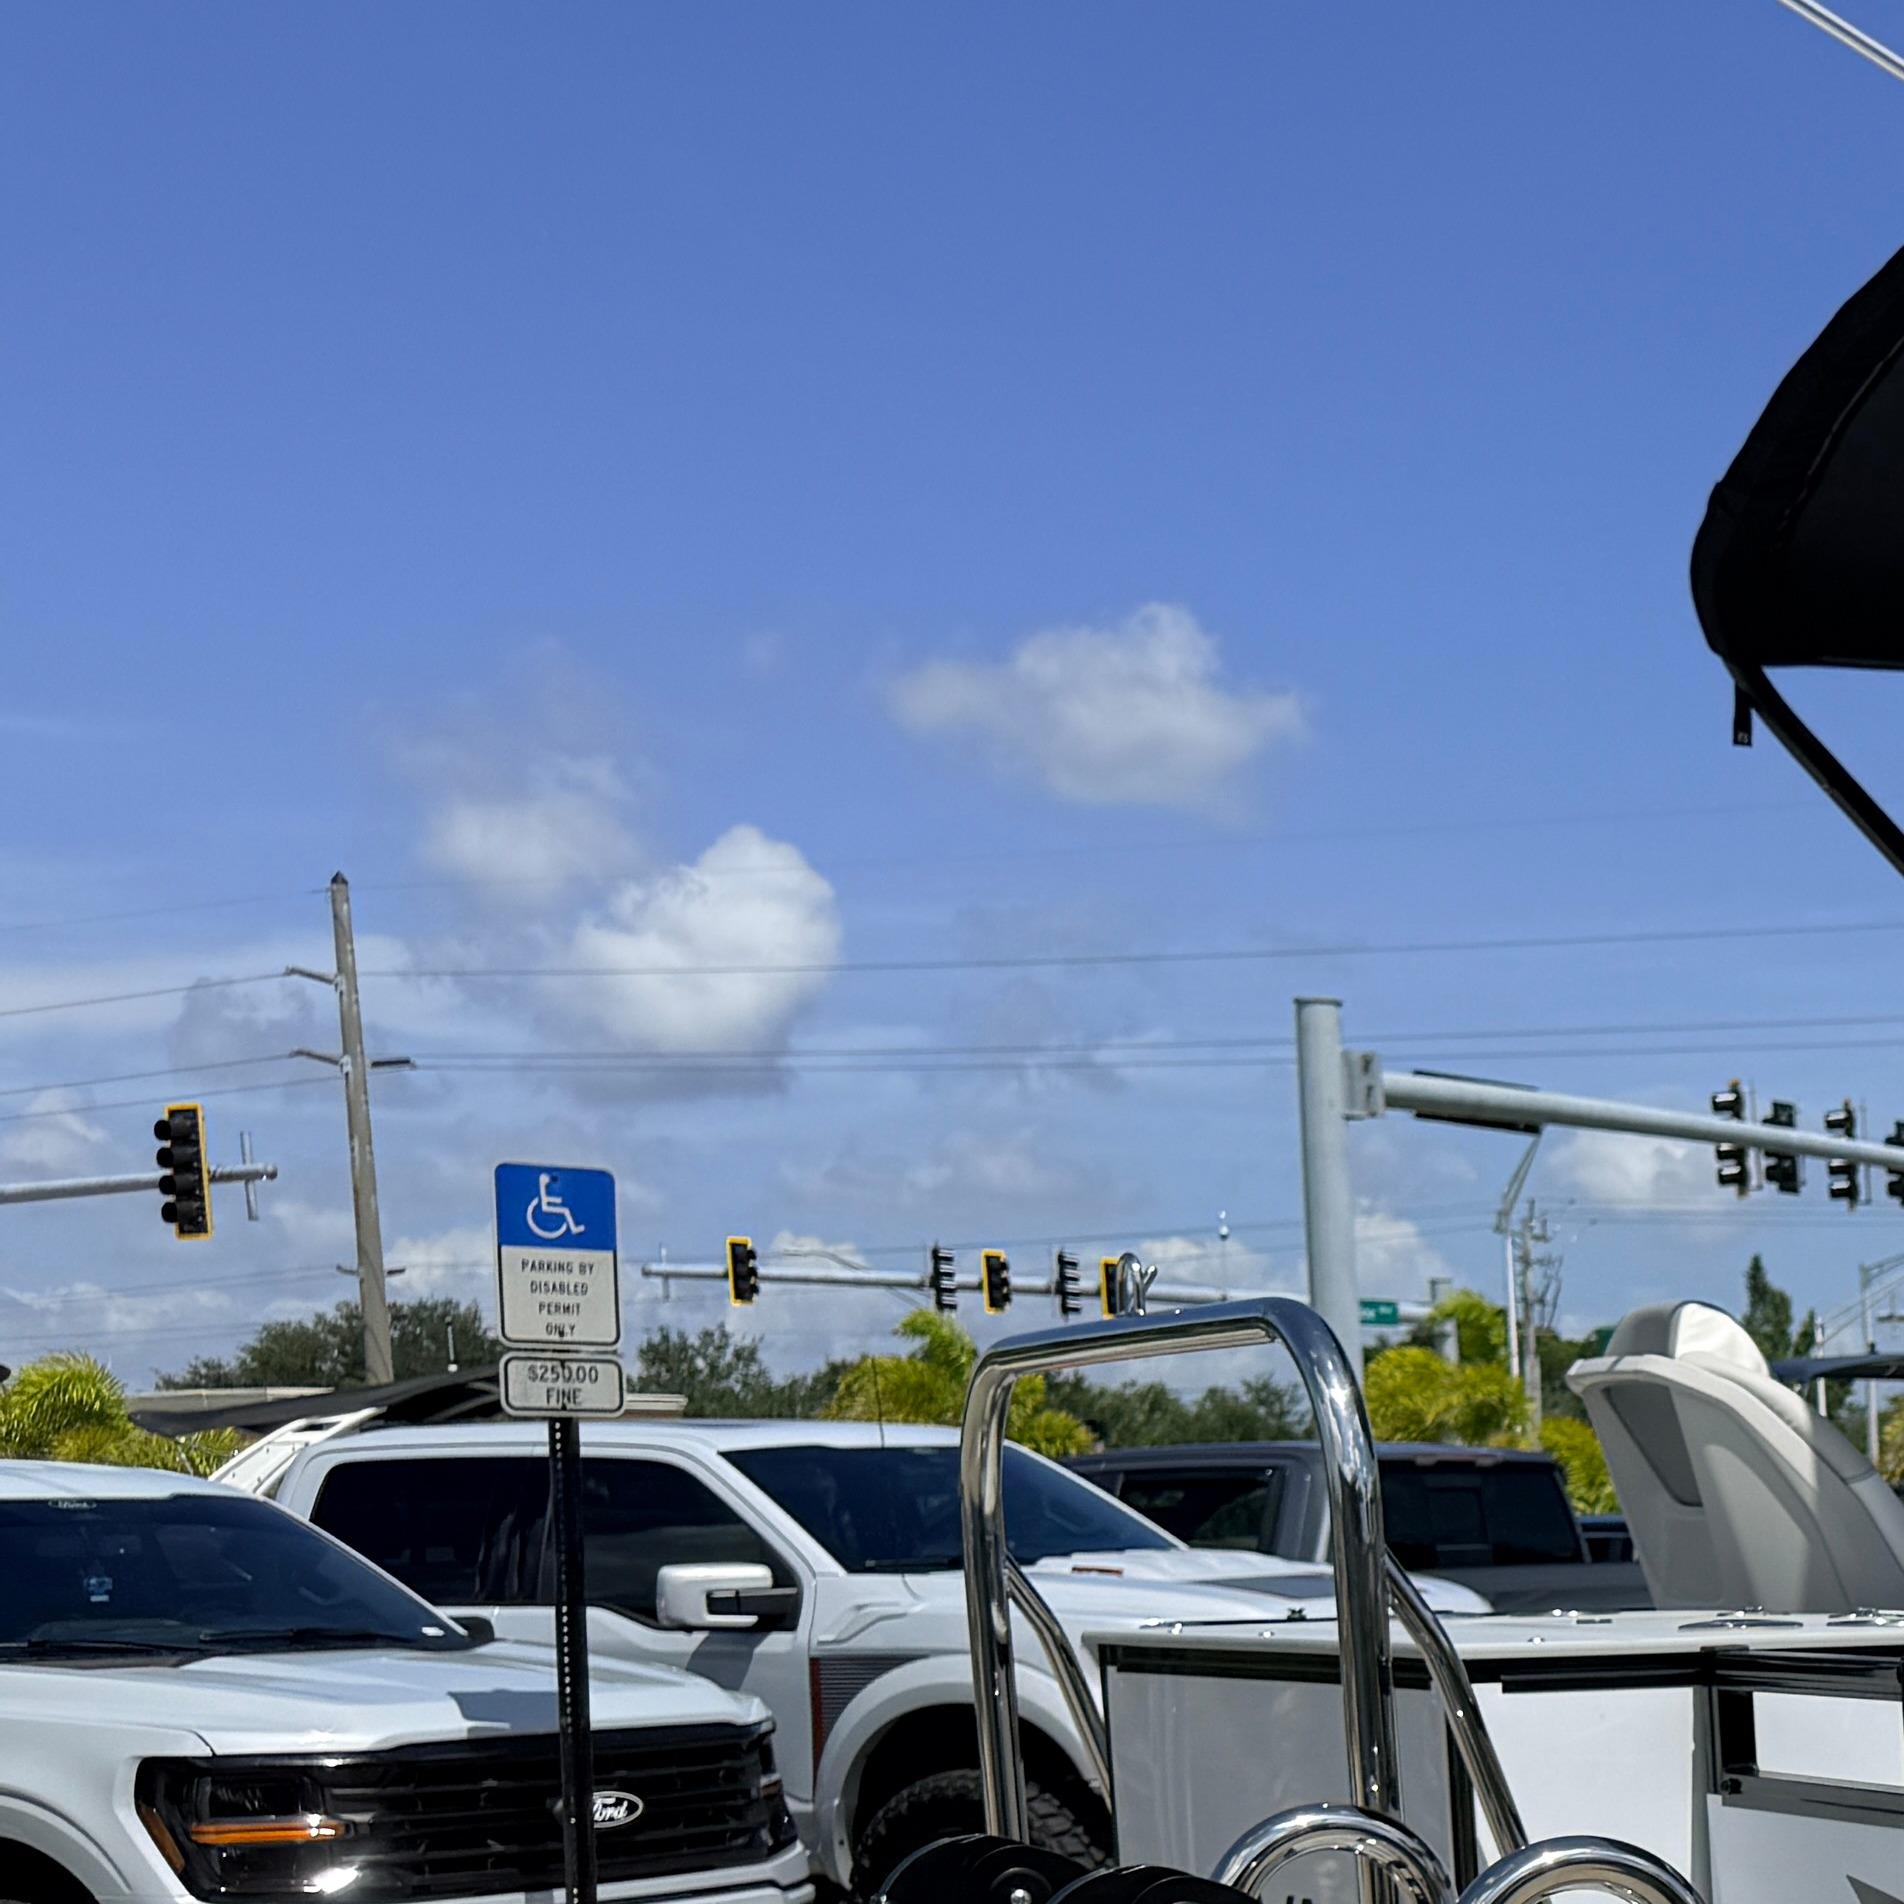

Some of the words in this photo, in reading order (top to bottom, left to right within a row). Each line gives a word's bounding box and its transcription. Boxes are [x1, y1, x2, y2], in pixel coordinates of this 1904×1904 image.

[521, 1258, 574, 1275] PARKING
[578, 1261, 595, 1276] BY
[530, 1281, 589, 1296] DISABLED
[538, 1303, 581, 1317] PERMIT
[545, 1322, 576, 1338] ONLY
[527, 1363, 599, 1384] $250.00
[545, 1387, 583, 1406] FINE
